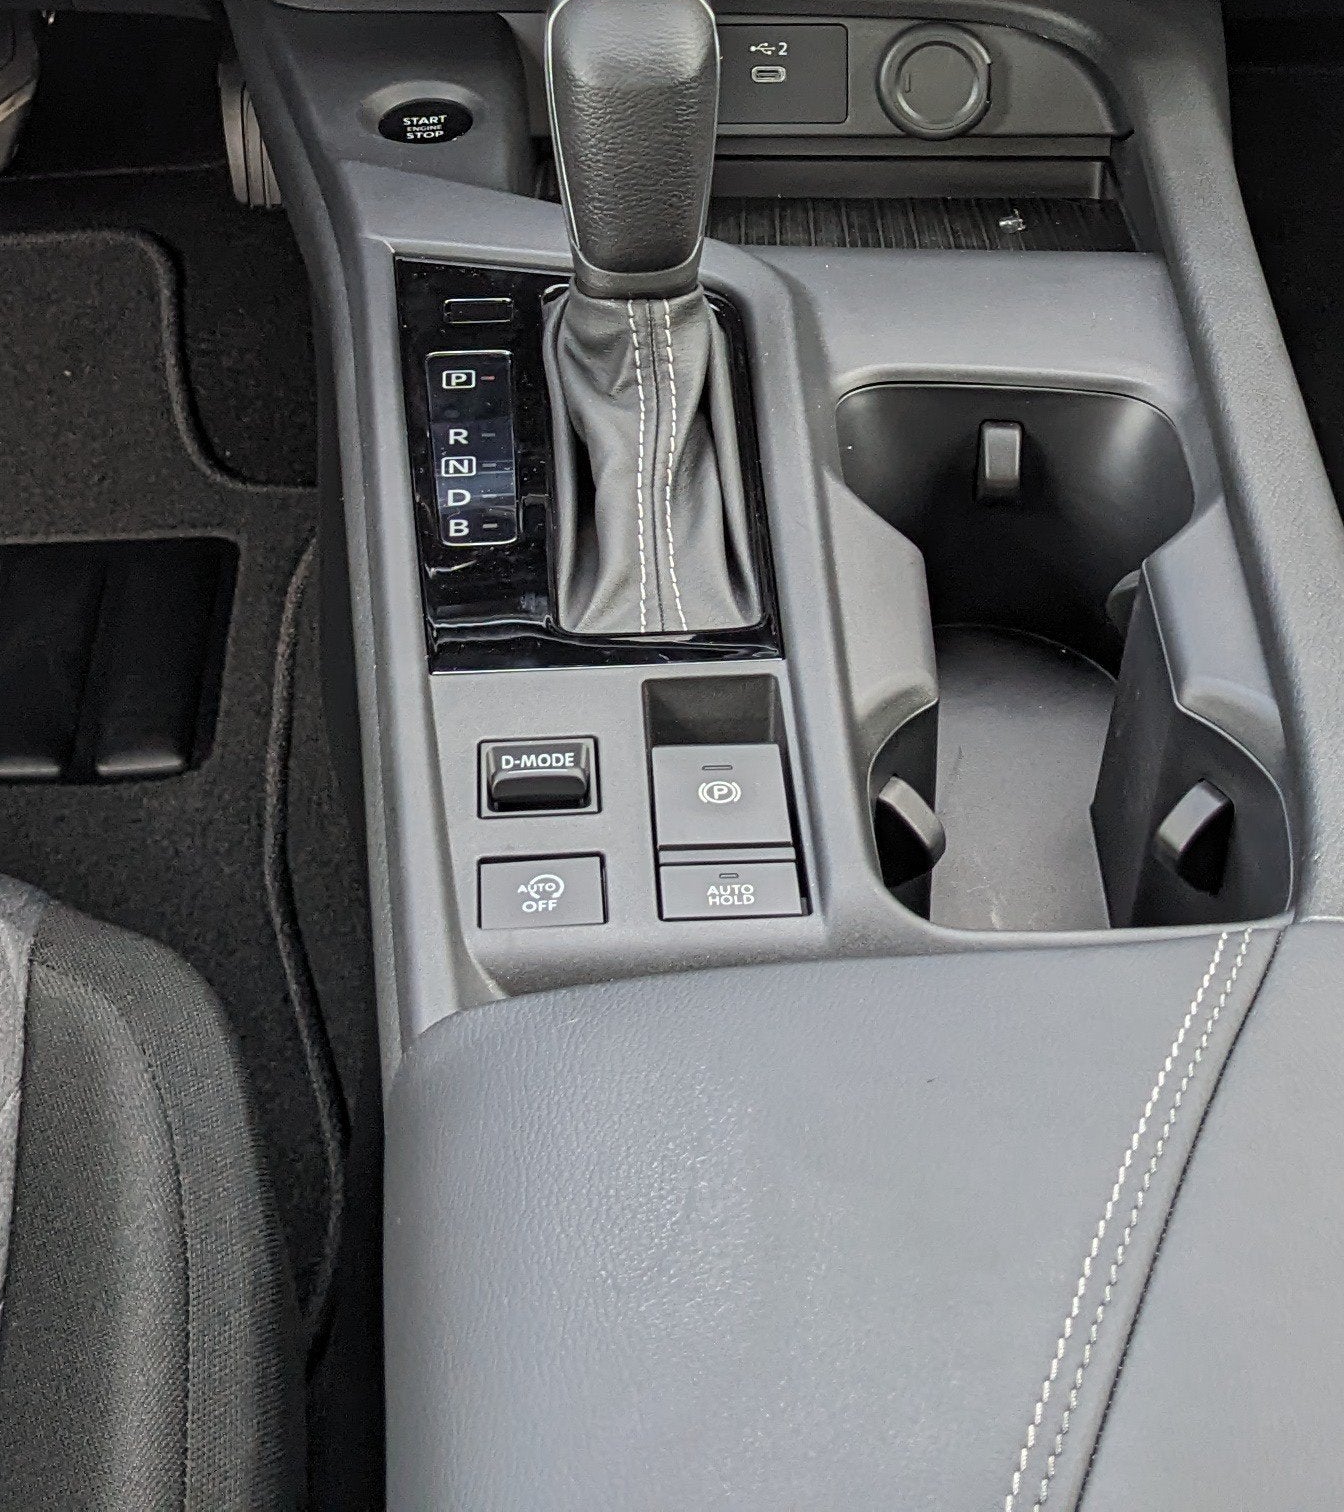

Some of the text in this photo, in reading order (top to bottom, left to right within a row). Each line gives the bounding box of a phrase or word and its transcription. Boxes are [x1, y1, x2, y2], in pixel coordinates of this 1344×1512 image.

[778, 42, 787, 56] 2
[403, 115, 447, 125] START
[406, 131, 444, 139] STOP
[451, 374, 467, 386] P
[448, 429, 468, 444] R
[448, 460, 469, 473] N
[448, 490, 471, 506] D
[448, 520, 469, 537] B
[501, 753, 574, 769] D-MODE
[518, 883, 556, 893] AUTO
[707, 885, 754, 895] AUTO
[522, 900, 557, 912] OFF
[709, 895, 754, 905] HOLD
